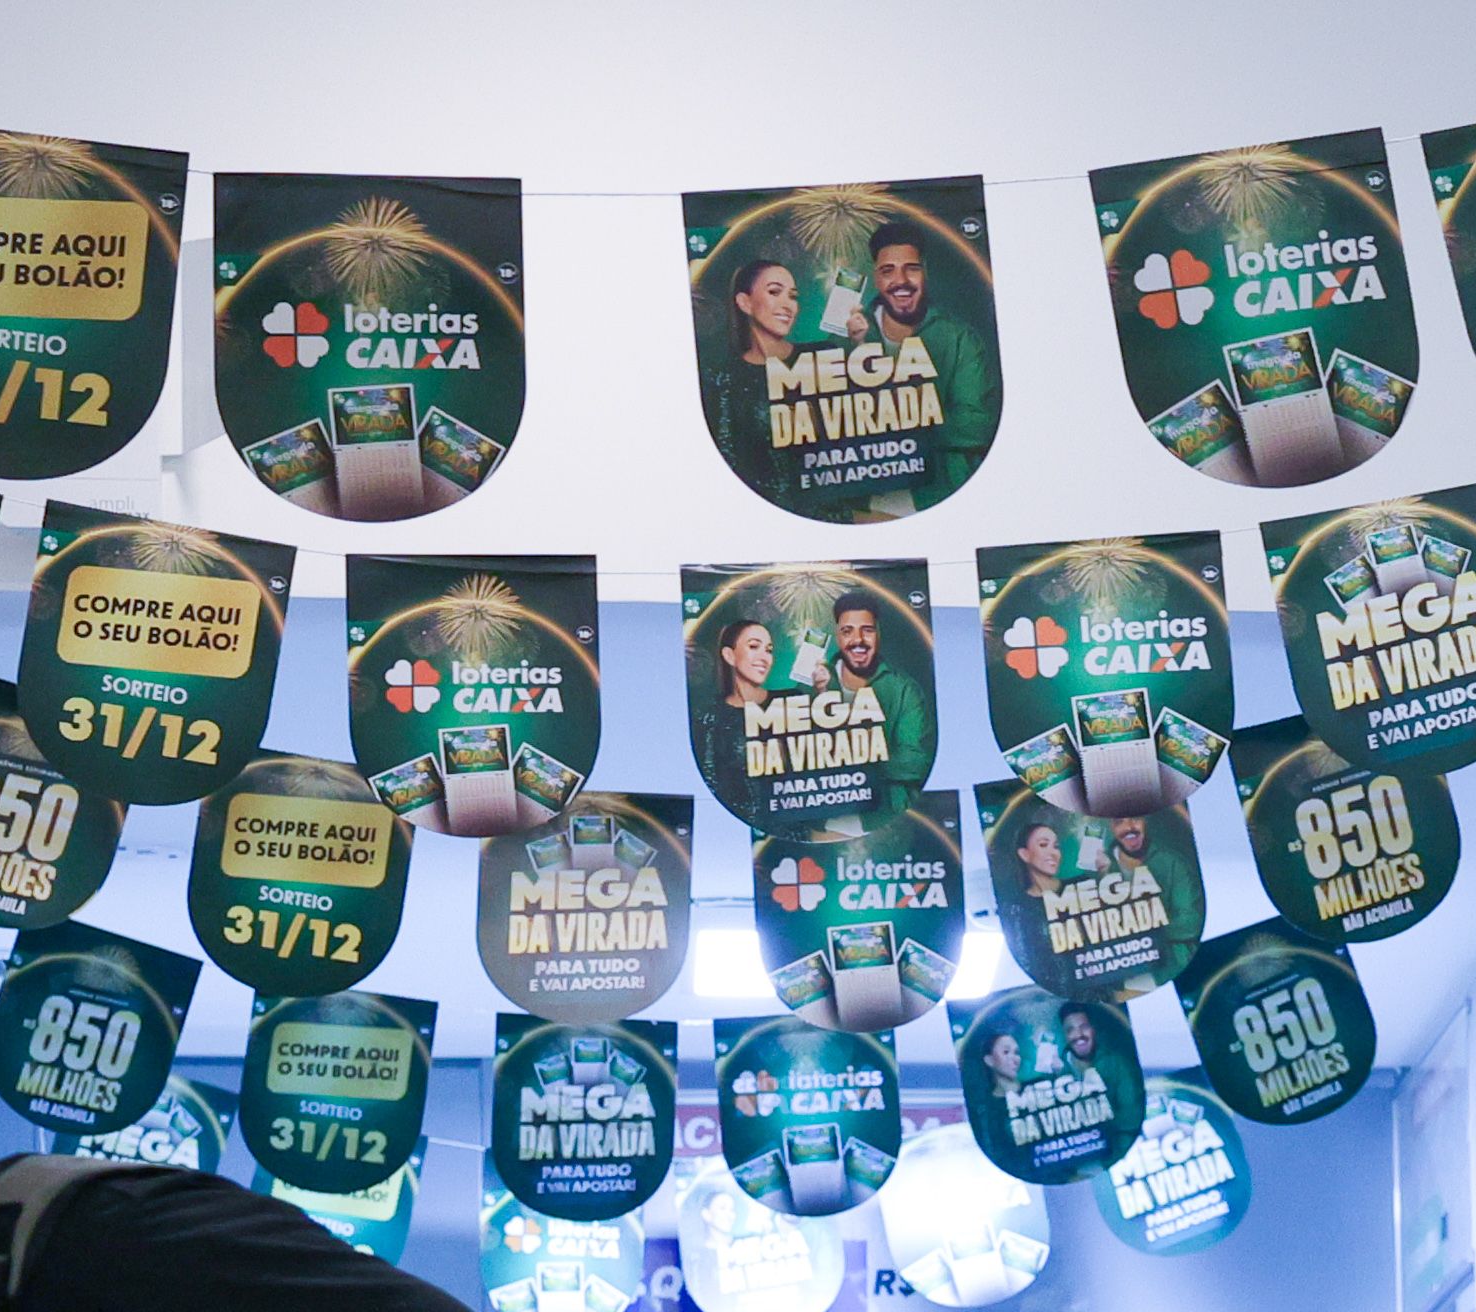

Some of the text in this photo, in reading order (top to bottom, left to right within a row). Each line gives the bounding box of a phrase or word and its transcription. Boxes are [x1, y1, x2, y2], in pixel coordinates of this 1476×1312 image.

[51, 232, 126, 257] AQUI
[1224, 230, 1377, 277] loterias
[15, 261, 125, 289] BOLÃO!
[1234, 266, 1386, 317] CAIXA
[344, 304, 479, 336] loterias
[345, 338, 481, 369] CAIXA
[765, 337, 937, 400] MEGA
[770, 382, 943, 448] DA VIRADA
[804, 439, 917, 468] PARA TUDO
[844, 458, 924, 483] APOSTAR!
[74, 594, 241, 625] COMPRE AQUI
[74, 621, 238, 652] O SEU BOLÃO!
[101, 675, 188, 704] SORTEIO
[744, 687, 886, 737] MEGA
[58, 698, 221, 765] 31/12
[806, 788, 871, 807] APOSTAR!
[234, 817, 376, 843] COMPRE AQUI
[1295, 774, 1413, 879] 850
[255, 840, 292, 859] SEU
[259, 885, 332, 911] SORTEIO
[510, 867, 668, 912] MEGA
[1043, 866, 1161, 920] MEGA
[224, 905, 362, 963] 31/12
[300, 1101, 362, 1121] SORTEIO
